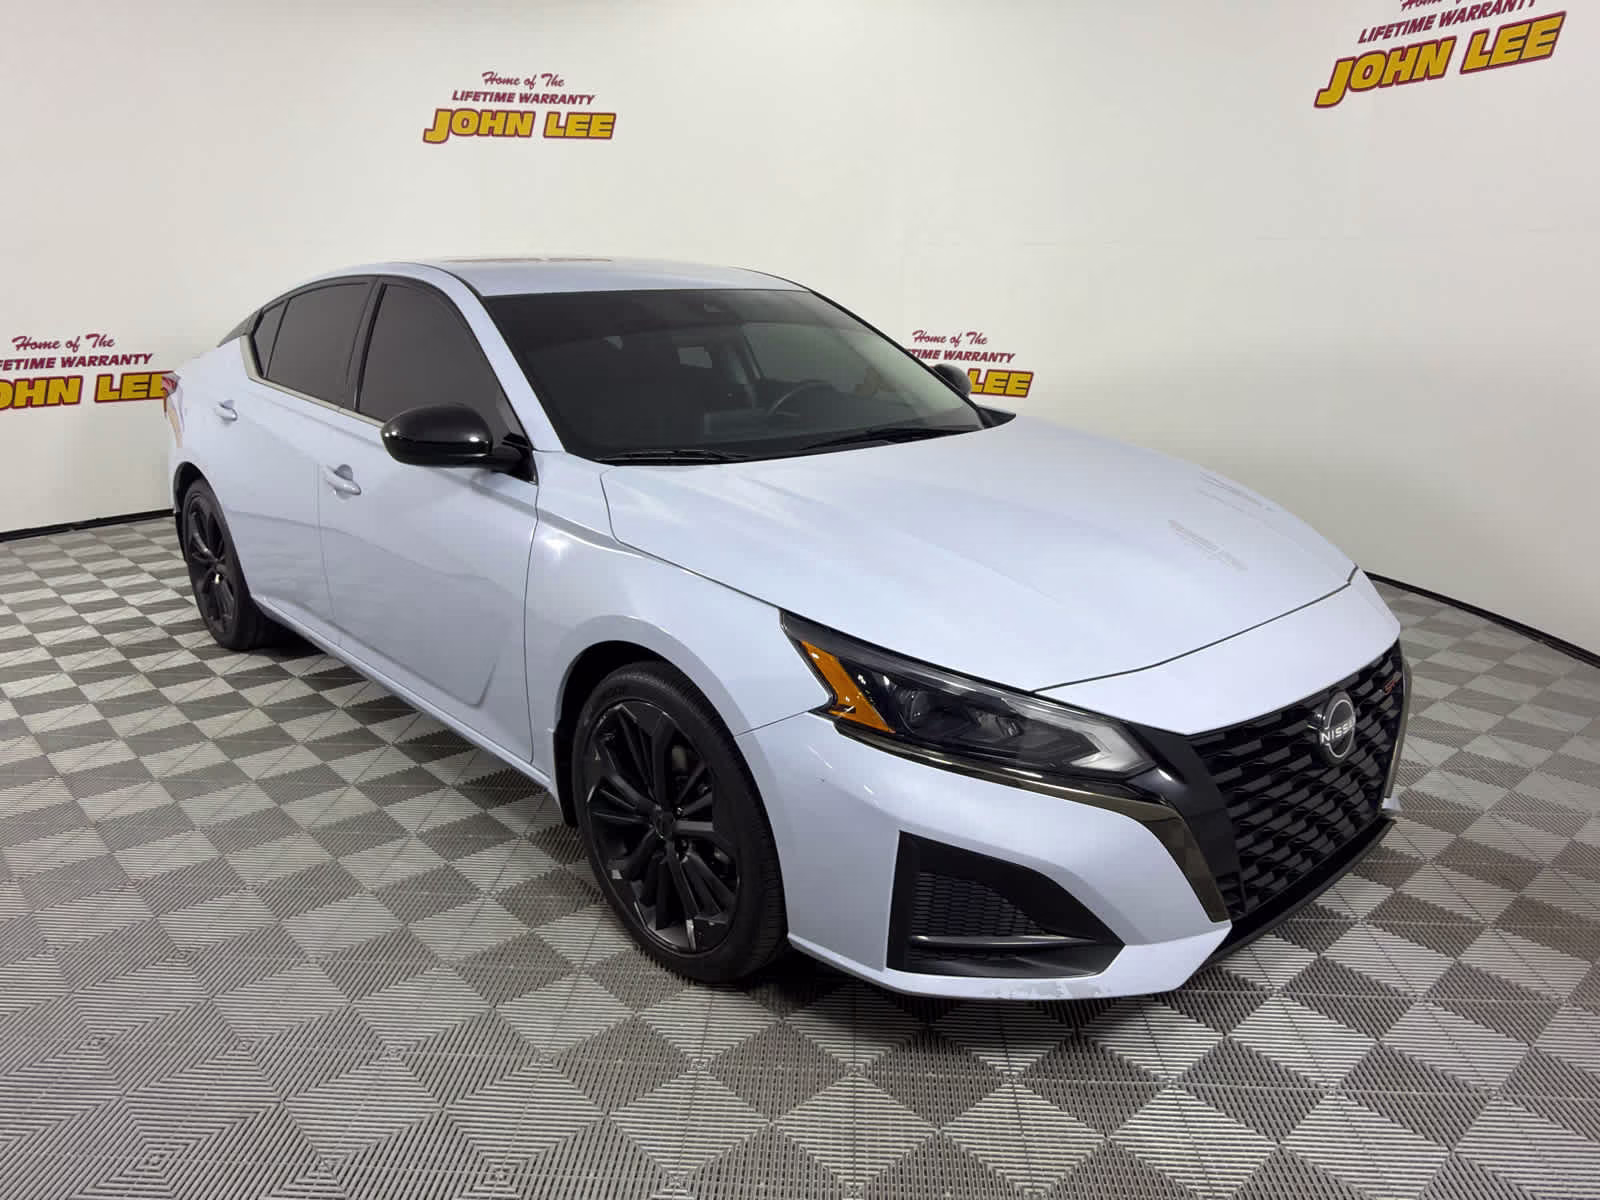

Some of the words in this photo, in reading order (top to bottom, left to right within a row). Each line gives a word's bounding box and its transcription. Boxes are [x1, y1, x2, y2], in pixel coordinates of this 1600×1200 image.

[1358, 14, 1437, 44] LIFETIME
[1314, 36, 1457, 108] JOHN
[1460, 11, 1566, 74] LEE
[481, 71, 520, 86] Home
[524, 74, 537, 89] of
[541, 73, 565, 87] The
[452, 90, 515, 103] LIFETIME
[519, 92, 595, 105] WARRANTY
[423, 108, 536, 144] JOHN
[543, 111, 617, 140] LEE
[11, 336, 61, 351] Home
[65, 336, 80, 352] of
[86, 333, 115, 348] The
[912, 329, 946, 343] Home
[949, 333, 962, 347] of
[966, 331, 988, 345] The
[61, 353, 152, 368] WARRANTY
[943, 350, 1016, 363] WARRANTY
[967, 368, 1034, 398] LEE
